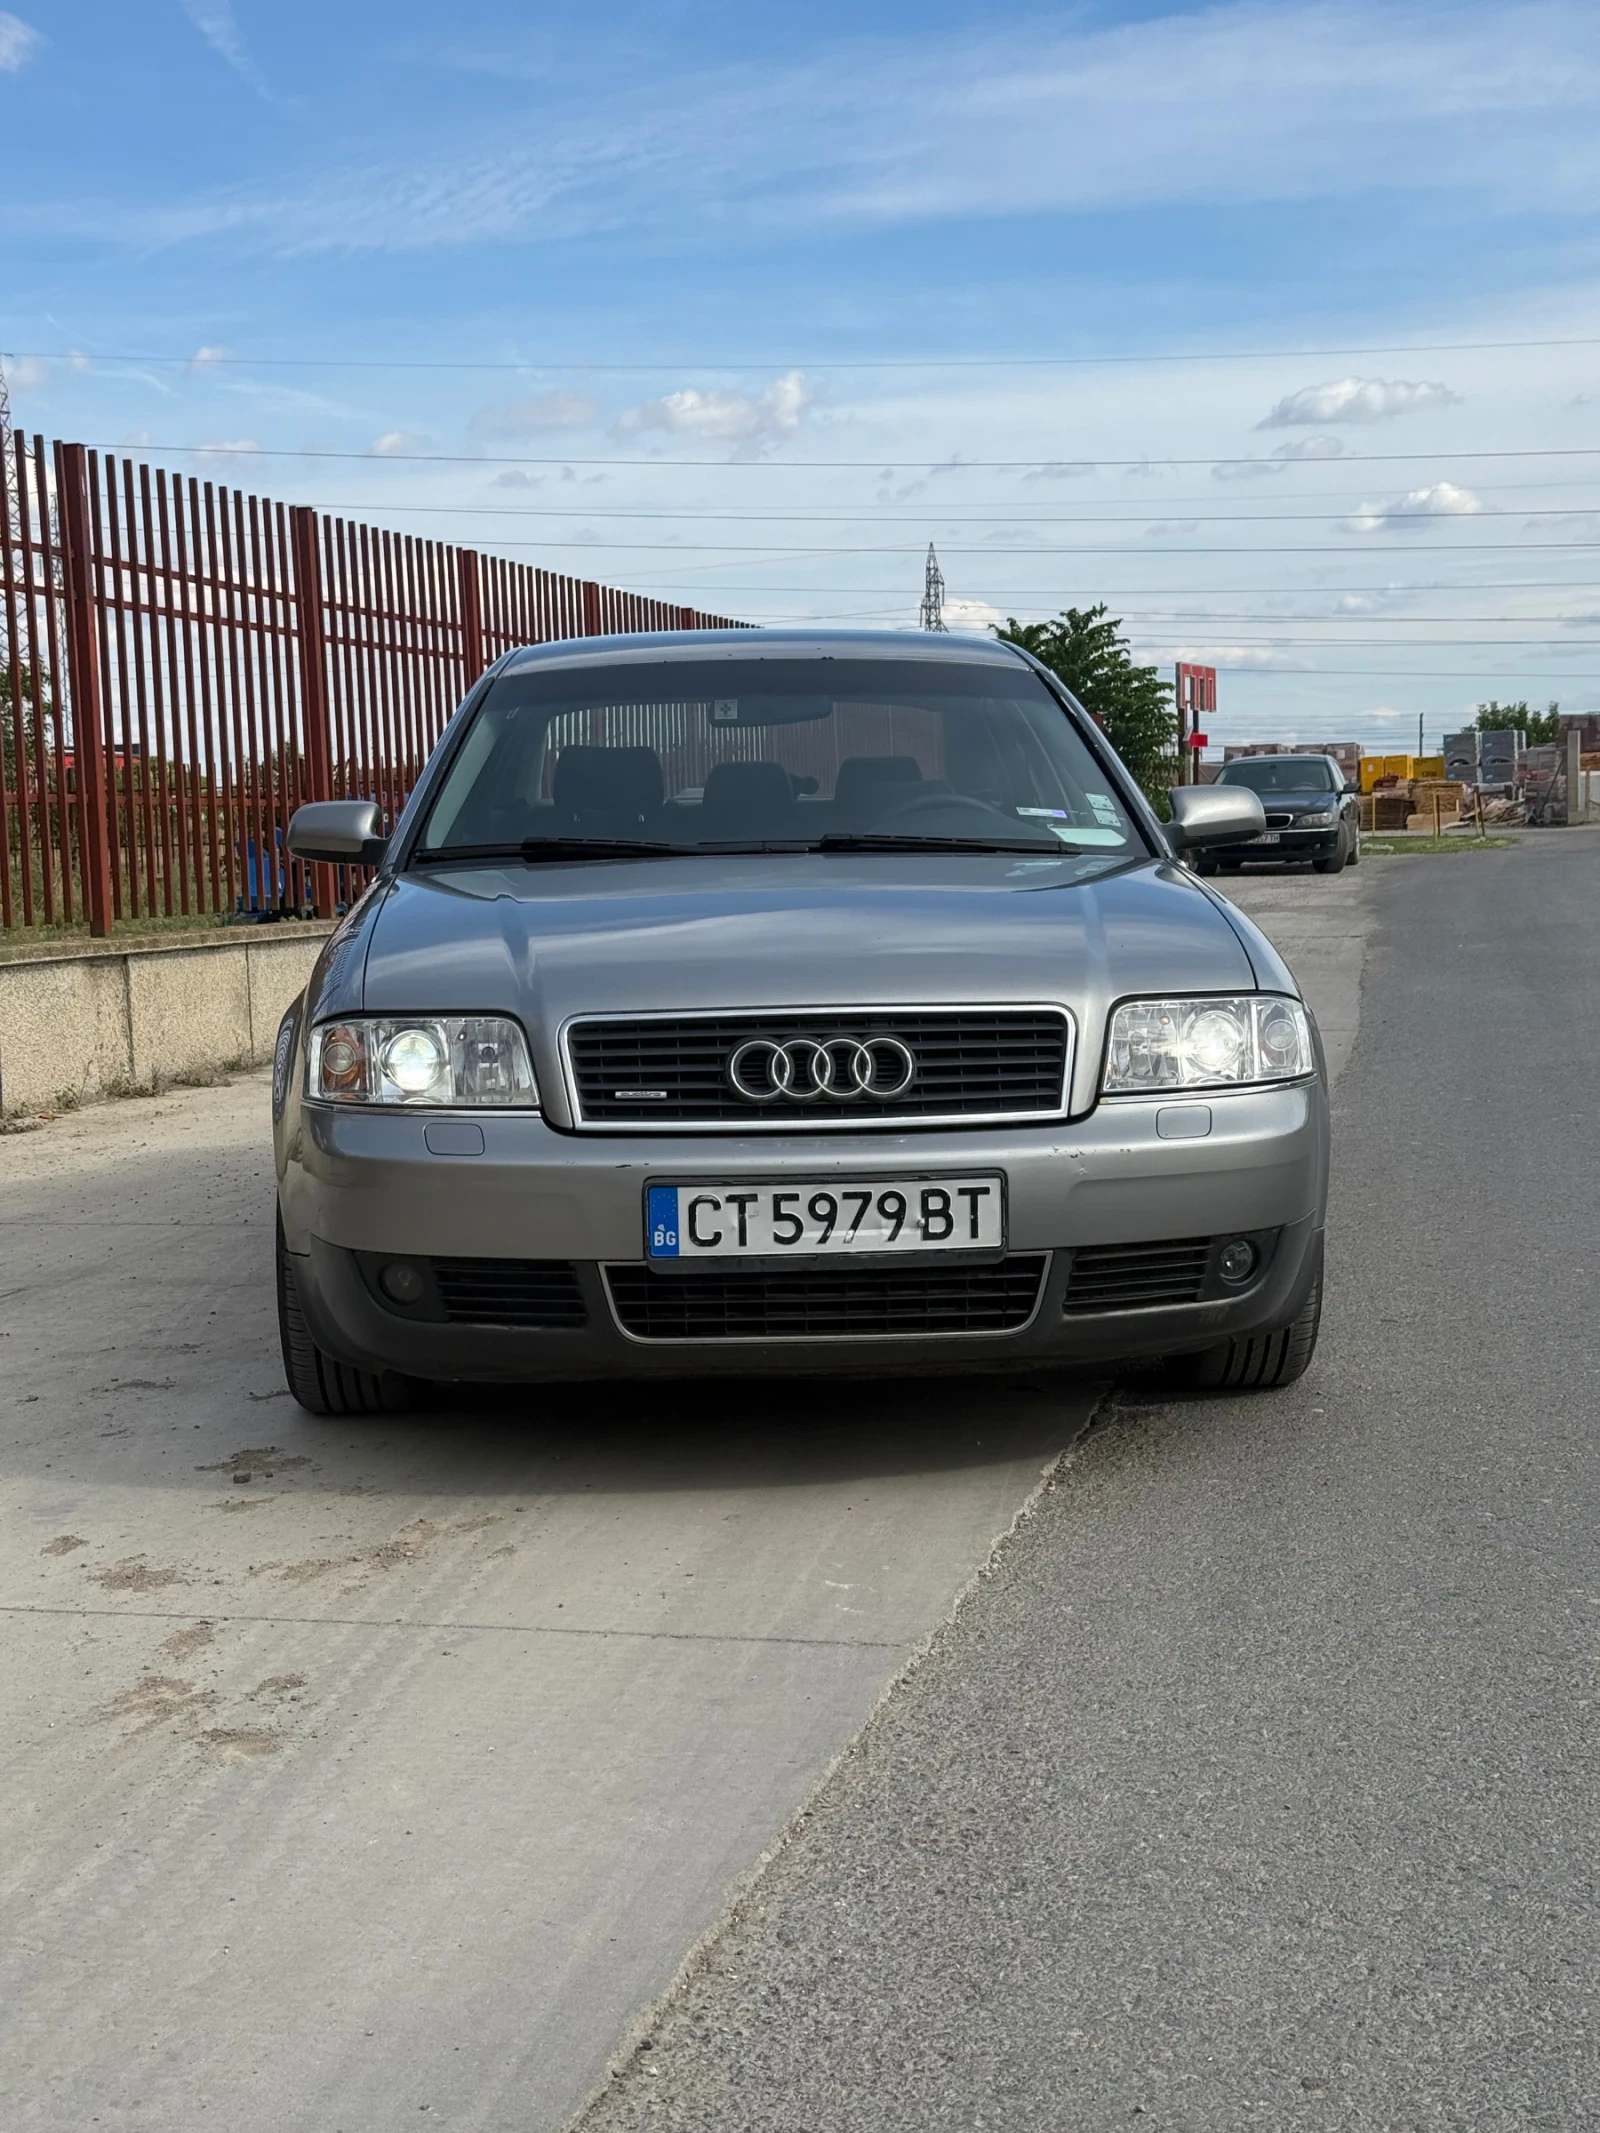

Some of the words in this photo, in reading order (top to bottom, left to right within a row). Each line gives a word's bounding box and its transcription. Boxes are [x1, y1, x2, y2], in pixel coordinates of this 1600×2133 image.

[688, 1194, 758, 1247] CT
[772, 1190, 907, 1245] 5979
[921, 1187, 991, 1241] BT
[654, 1231, 676, 1246] BG
